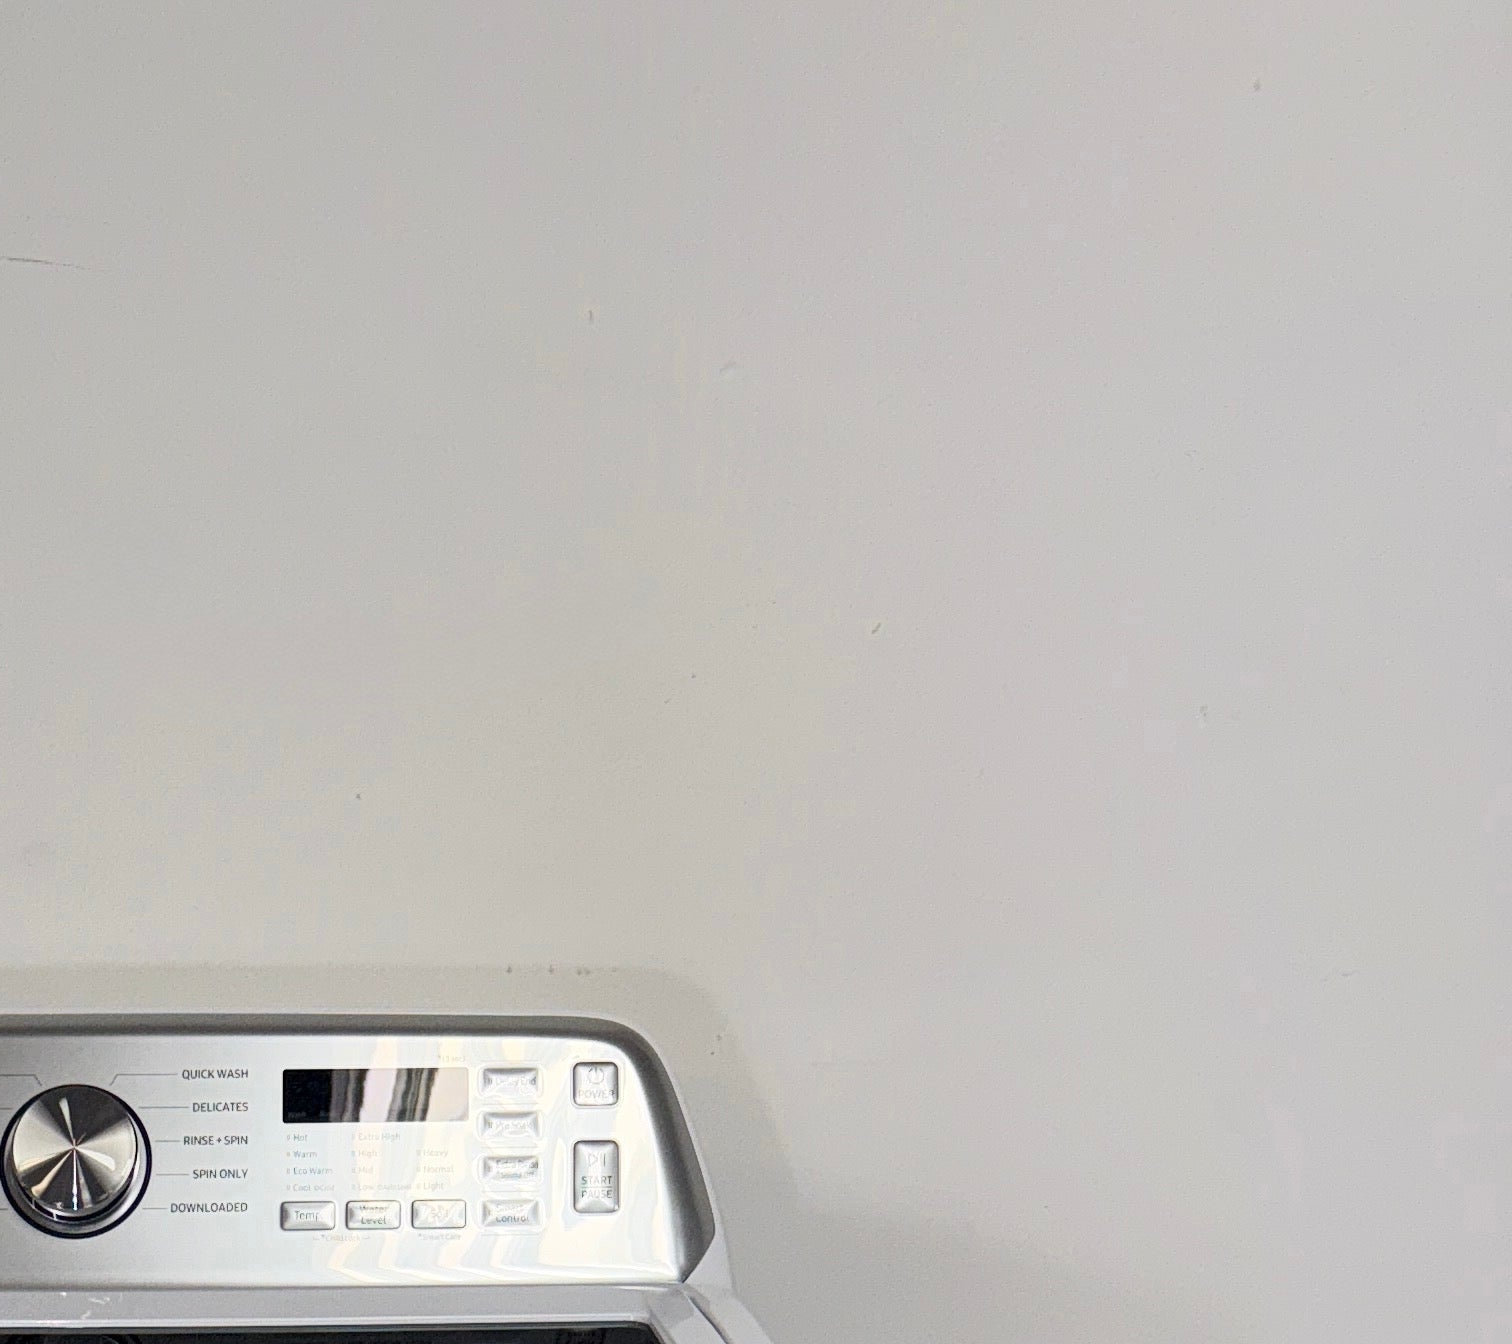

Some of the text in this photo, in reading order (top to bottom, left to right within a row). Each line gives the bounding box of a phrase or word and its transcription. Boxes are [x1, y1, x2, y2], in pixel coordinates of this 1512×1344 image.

[182, 1069, 249, 1080] QUICK WASH
[192, 1102, 249, 1113] DELICATES
[183, 1136, 215, 1146] RINSE
[224, 1135, 249, 1145] SPIN
[293, 1133, 308, 1142] Hot
[293, 1149, 318, 1159] Warm
[193, 1169, 248, 1179] SPIN ONLY
[581, 1175, 613, 1186] START
[423, 1181, 444, 1192] Light
[581, 1189, 613, 1200] PAUSE
[170, 1203, 248, 1213] DOWNLOADED
[361, 1216, 387, 1226] Level
